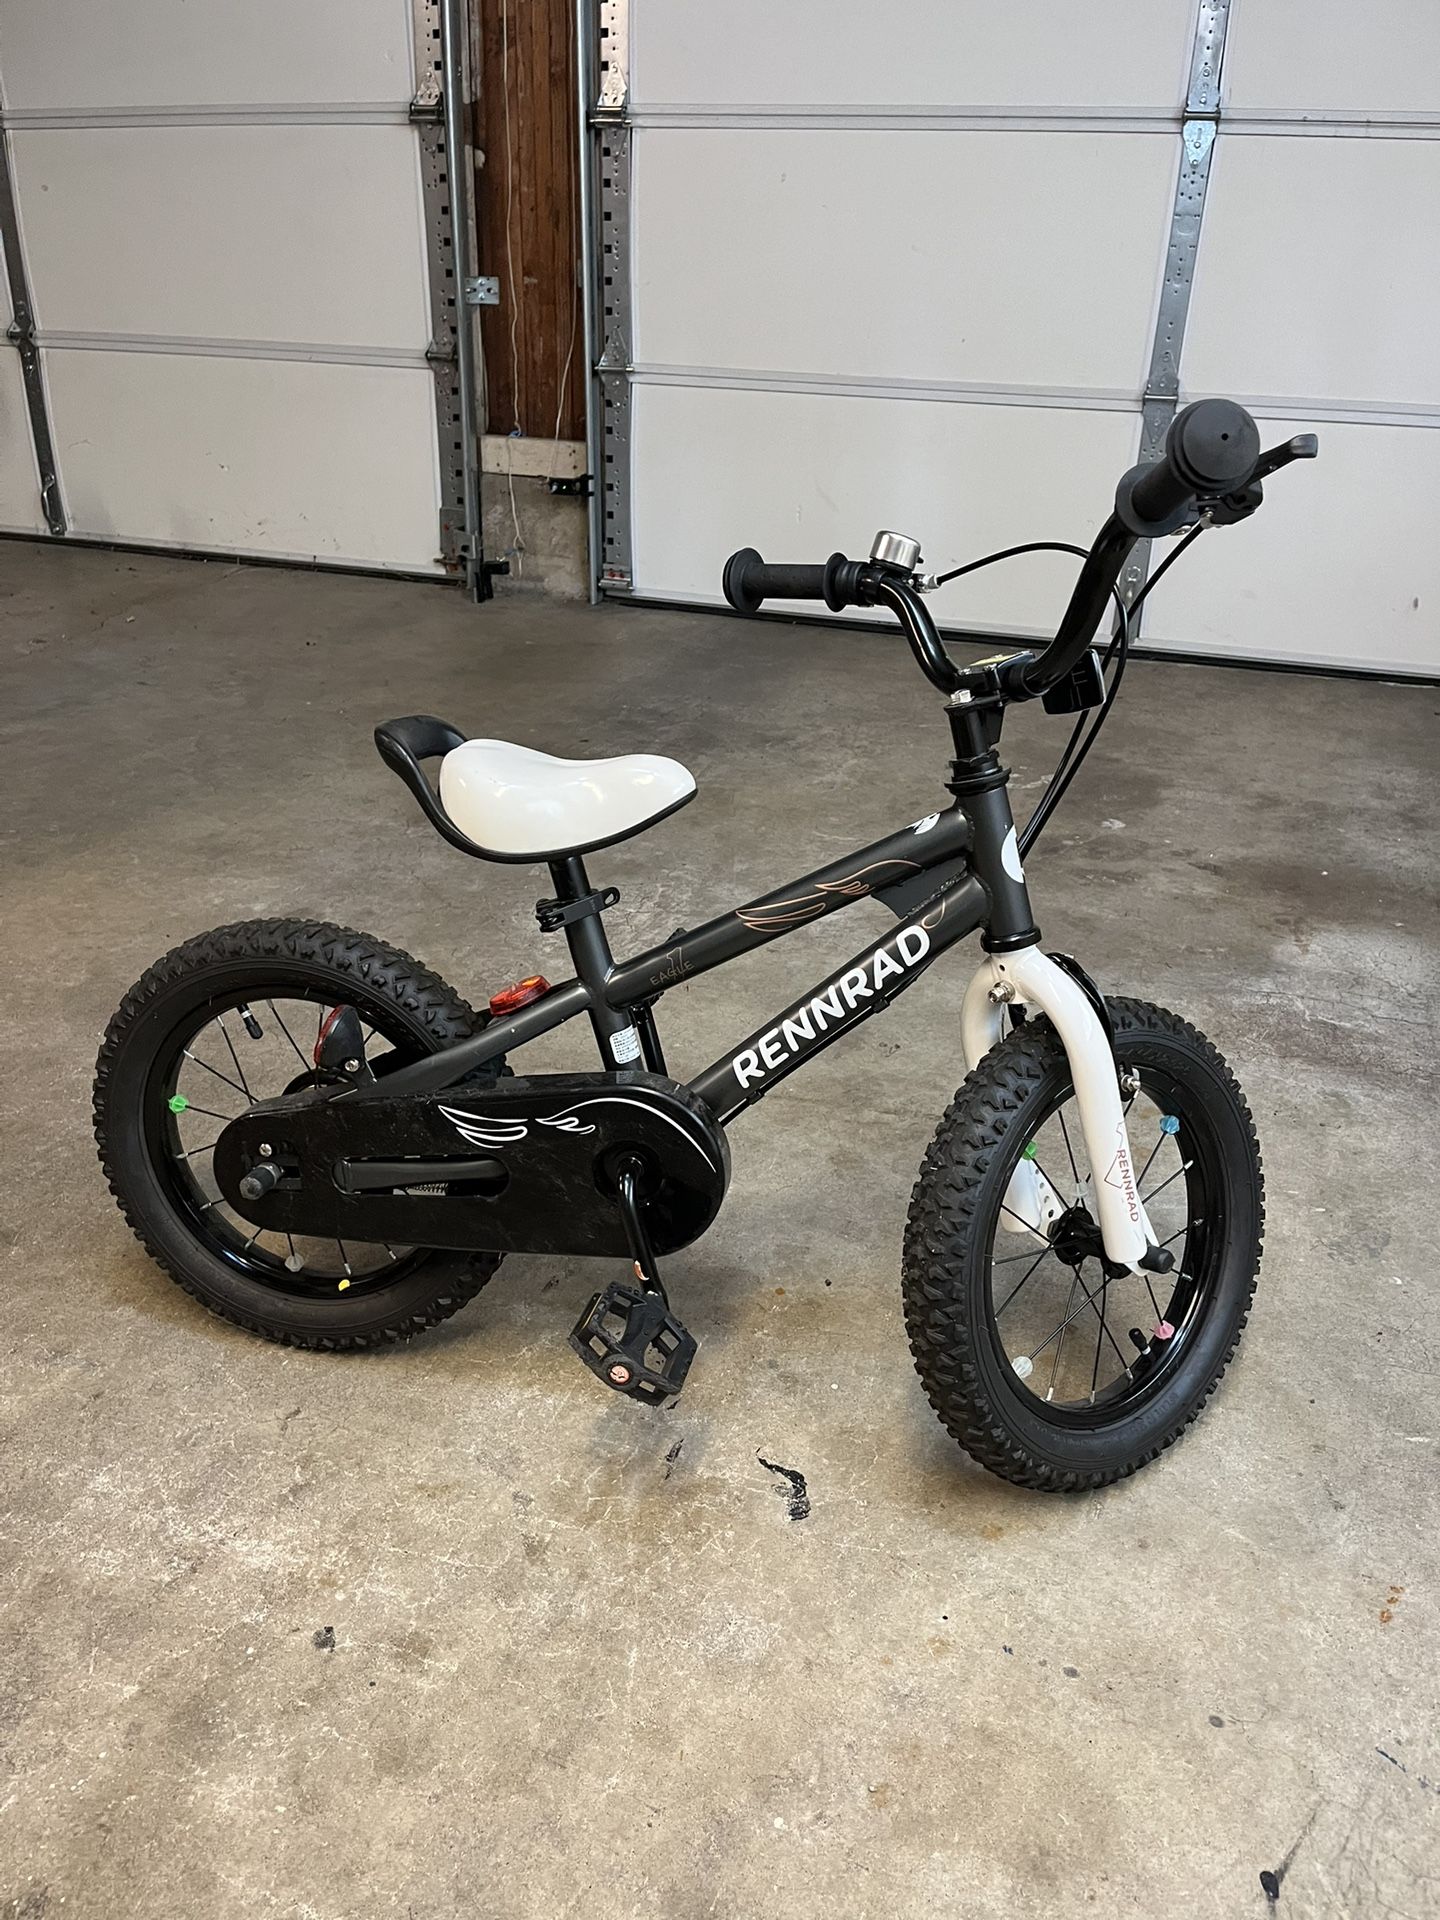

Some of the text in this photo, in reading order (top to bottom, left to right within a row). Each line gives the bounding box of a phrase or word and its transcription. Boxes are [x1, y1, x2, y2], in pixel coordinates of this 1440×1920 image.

[650, 961, 695, 986] EAGLE
[732, 925, 931, 1089] RENNRAD
[1116, 1149, 1140, 1222] RENNRAD
